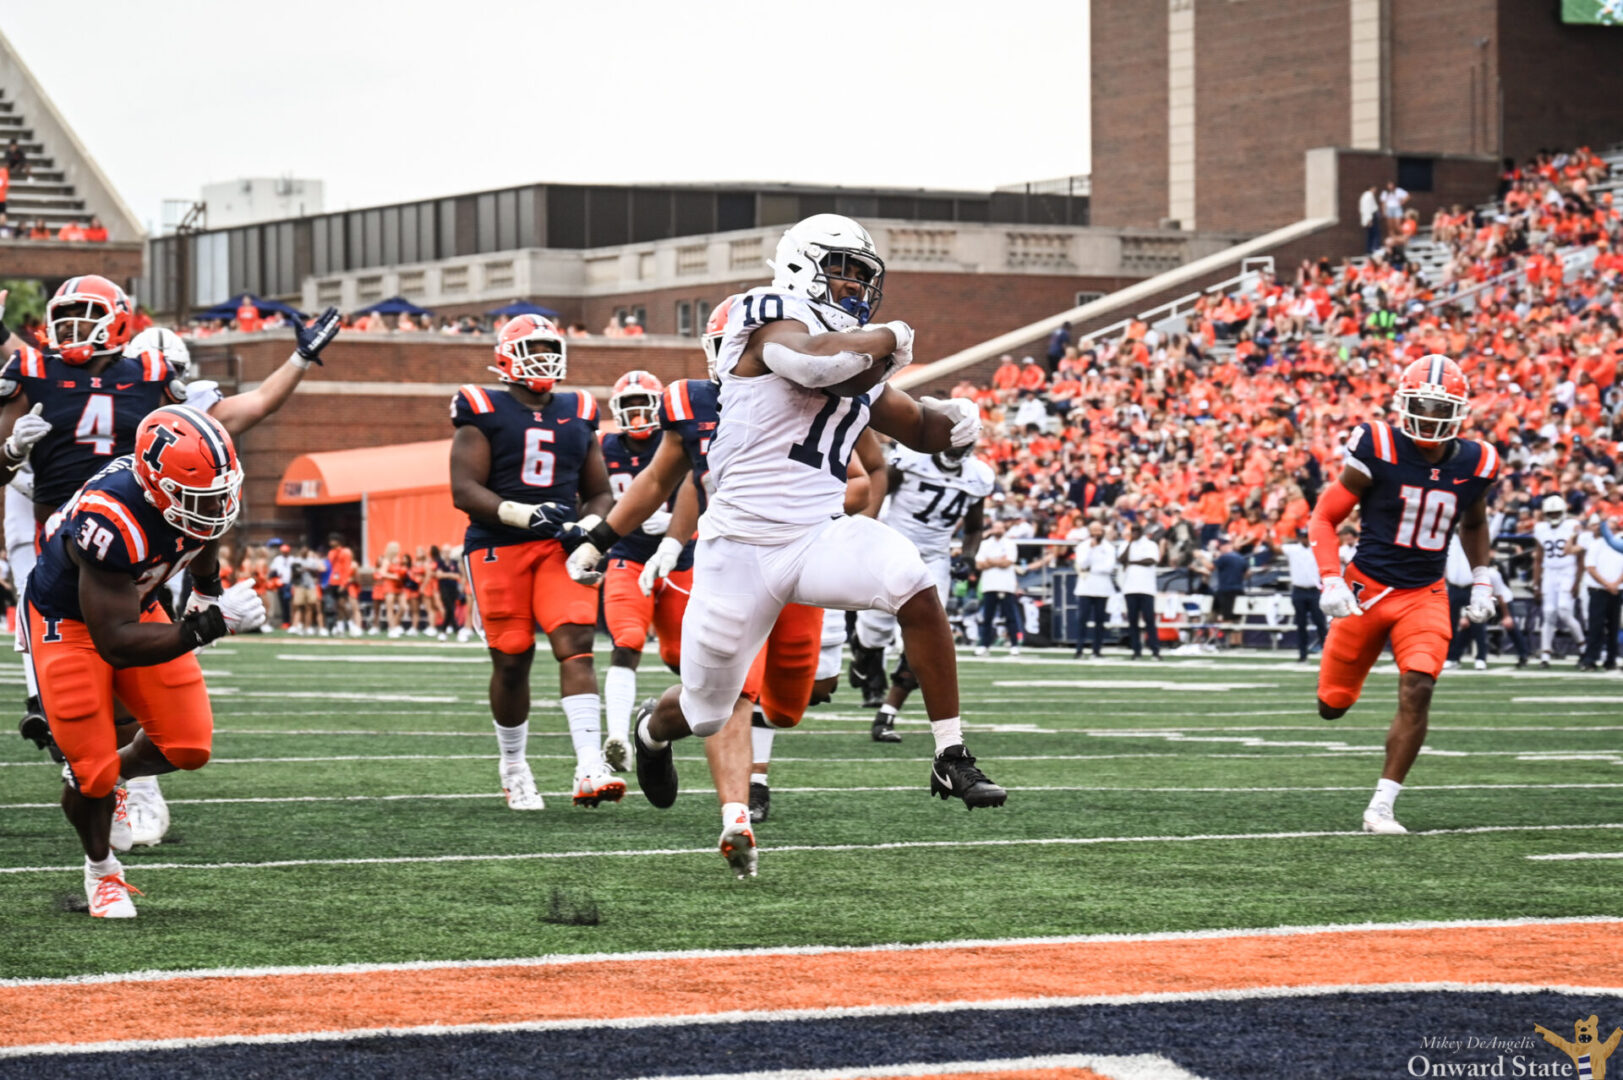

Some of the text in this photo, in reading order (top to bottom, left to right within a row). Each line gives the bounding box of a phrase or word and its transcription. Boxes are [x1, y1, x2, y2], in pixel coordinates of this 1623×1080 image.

[743, 294, 784, 327] 10
[75, 393, 117, 455] 4
[788, 388, 870, 484] 10
[142, 425, 178, 472] I
[521, 427, 556, 487] 6
[912, 481, 968, 528] 74
[1394, 484, 1457, 551] 10
[76, 517, 114, 562] 39
[42, 616, 62, 643] I
